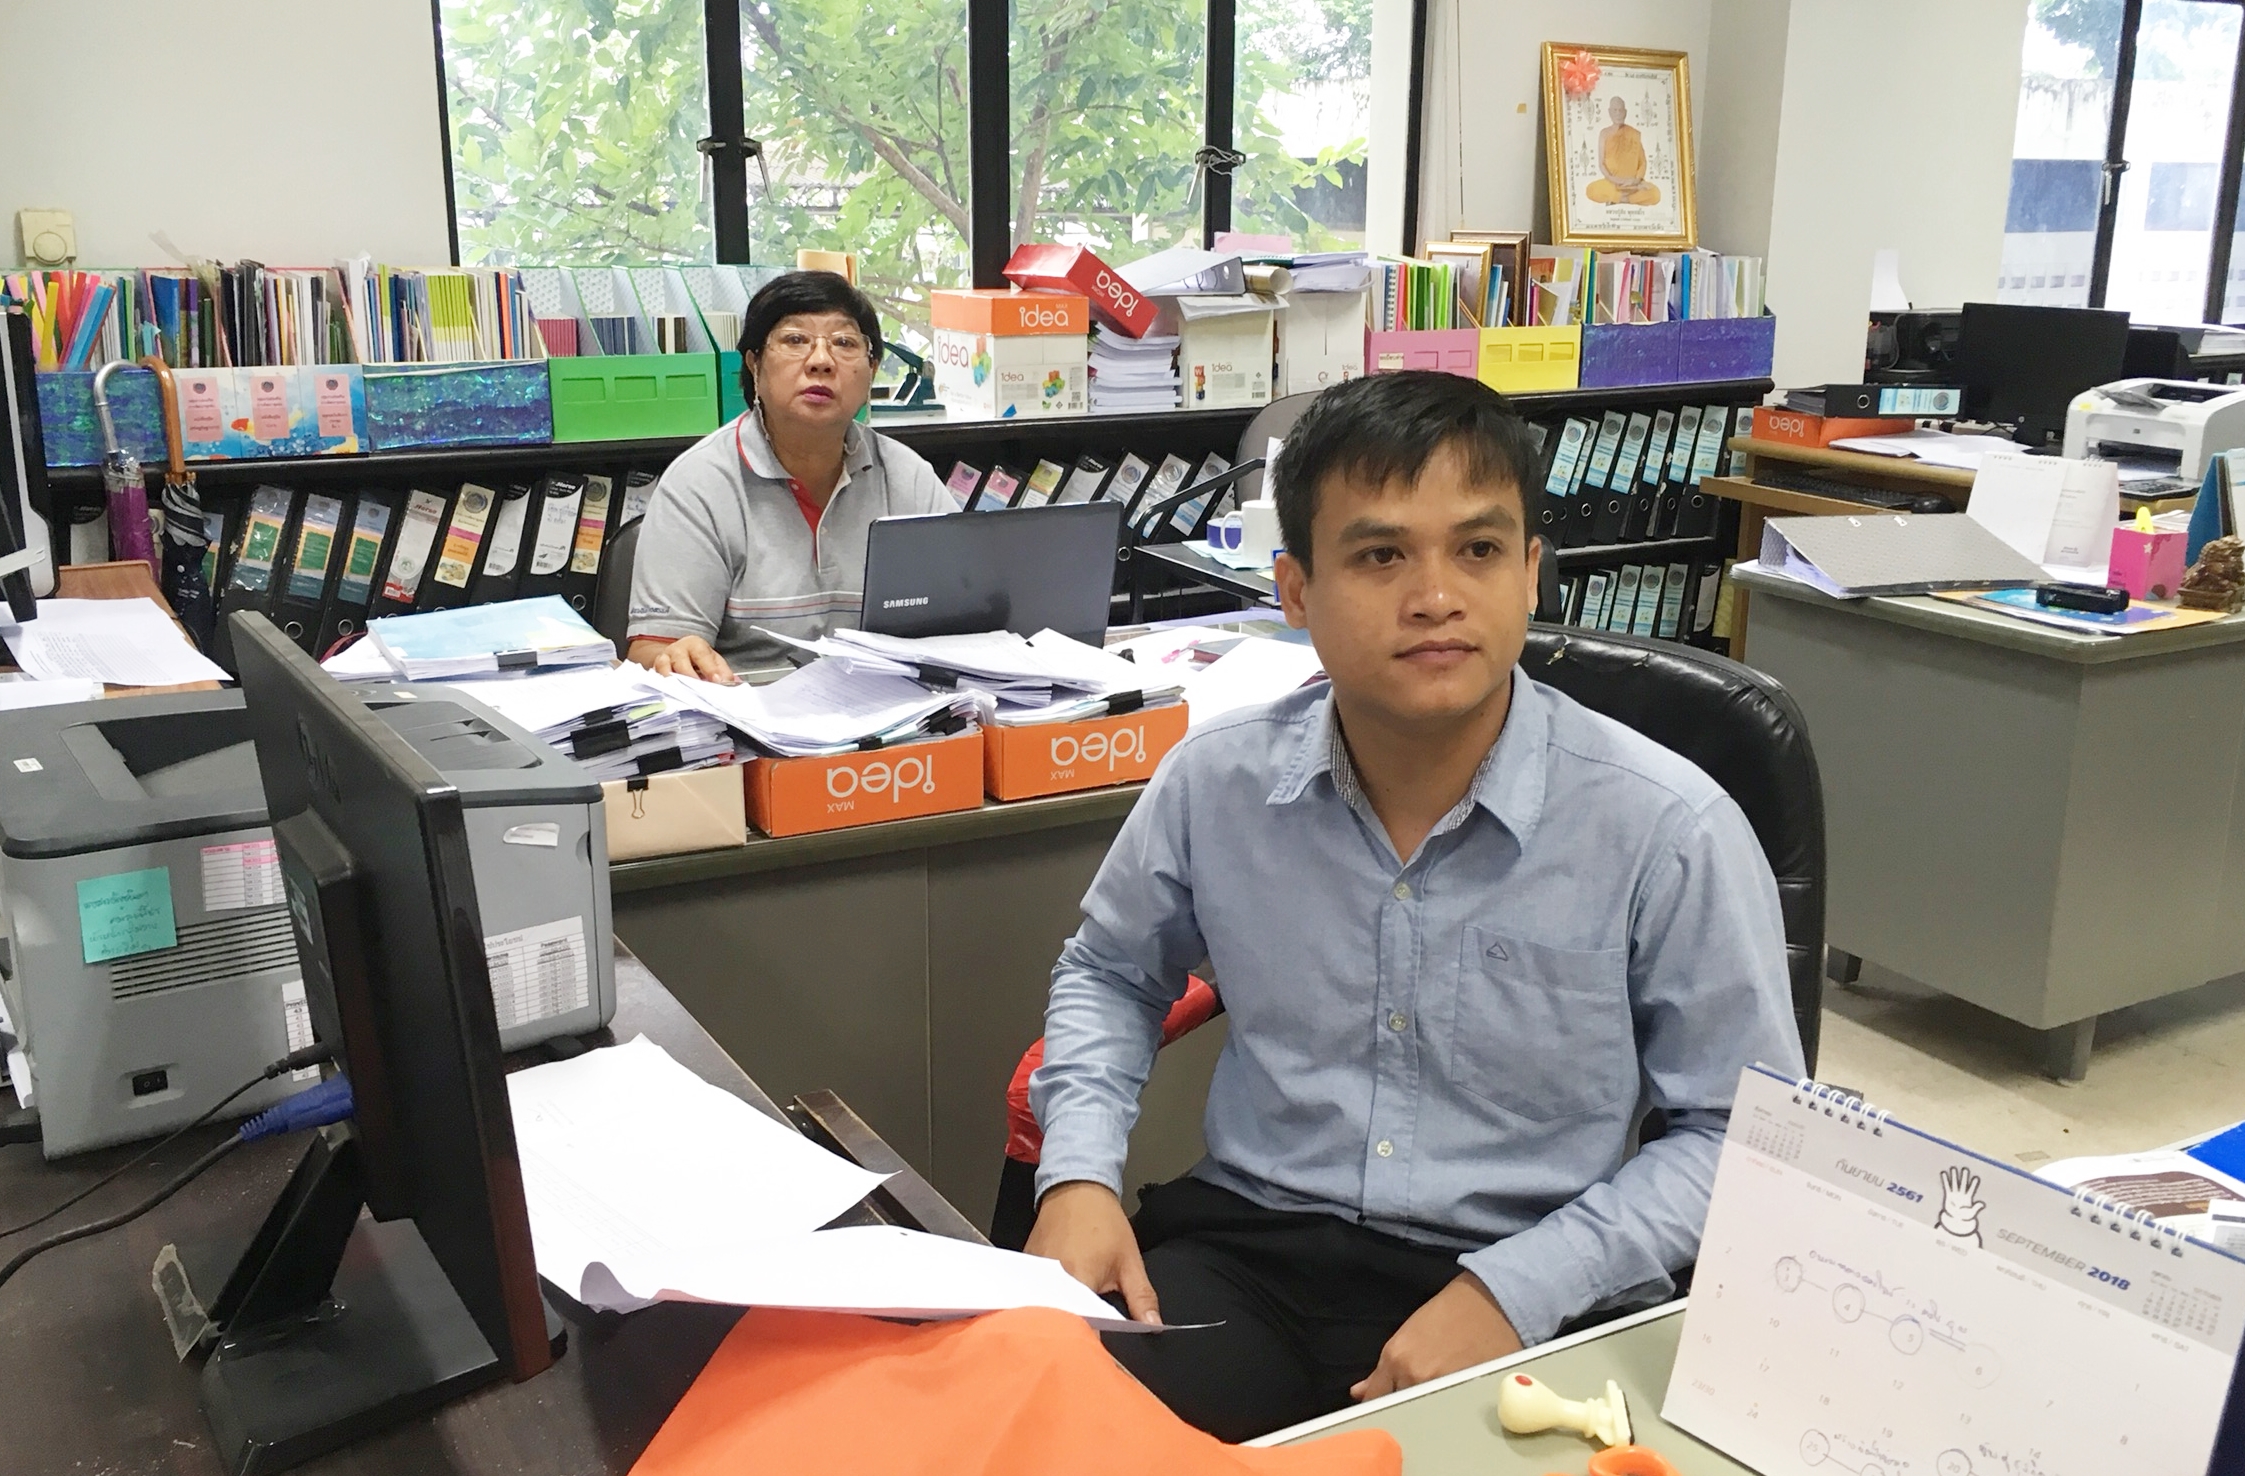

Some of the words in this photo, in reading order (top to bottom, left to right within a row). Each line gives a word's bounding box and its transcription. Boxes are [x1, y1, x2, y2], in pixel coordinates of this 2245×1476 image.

[1095, 269, 1139, 317] idea
[1018, 304, 1069, 328] idea
[937, 335, 969, 368] idea
[1211, 362, 1233, 372] idea
[1000, 371, 1025, 382] idea
[1769, 415, 1805, 438] idea
[883, 596, 929, 609] SAMSUNG
[1050, 725, 1146, 772] idea
[826, 754, 935, 804] idea
[1050, 769, 1075, 782] MAX
[826, 800, 855, 813] MAX
[1835, 1158, 1885, 1188] กันยายน
[1885, 1181, 1924, 1204] 2561
[1996, 1227, 2087, 1273] SEPTEMBER
[2086, 1266, 2131, 1291] 2018
[1843, 1303, 1852, 1313] 4
[1769, 1316, 1781, 1329] 10
[1702, 1332, 1713, 1345] 16
[1906, 1333, 1915, 1344] 5
[1829, 1347, 1841, 1359] 11
[1759, 1361, 1770, 1374] 17
[1974, 1365, 1984, 1377] 6
[1892, 1378, 1905, 1391] 12
[1819, 1393, 1831, 1407] 18
[2046, 1399, 2054, 1409] 7
[1746, 1408, 1759, 1420] 24
[1959, 1412, 1973, 1425] 13
[1881, 1426, 1894, 1439] 19
[1806, 1440, 1819, 1453] 25
[2119, 1434, 2129, 1446] 8
[2029, 1447, 2042, 1460] 14
[1946, 1461, 1961, 1474] 20
